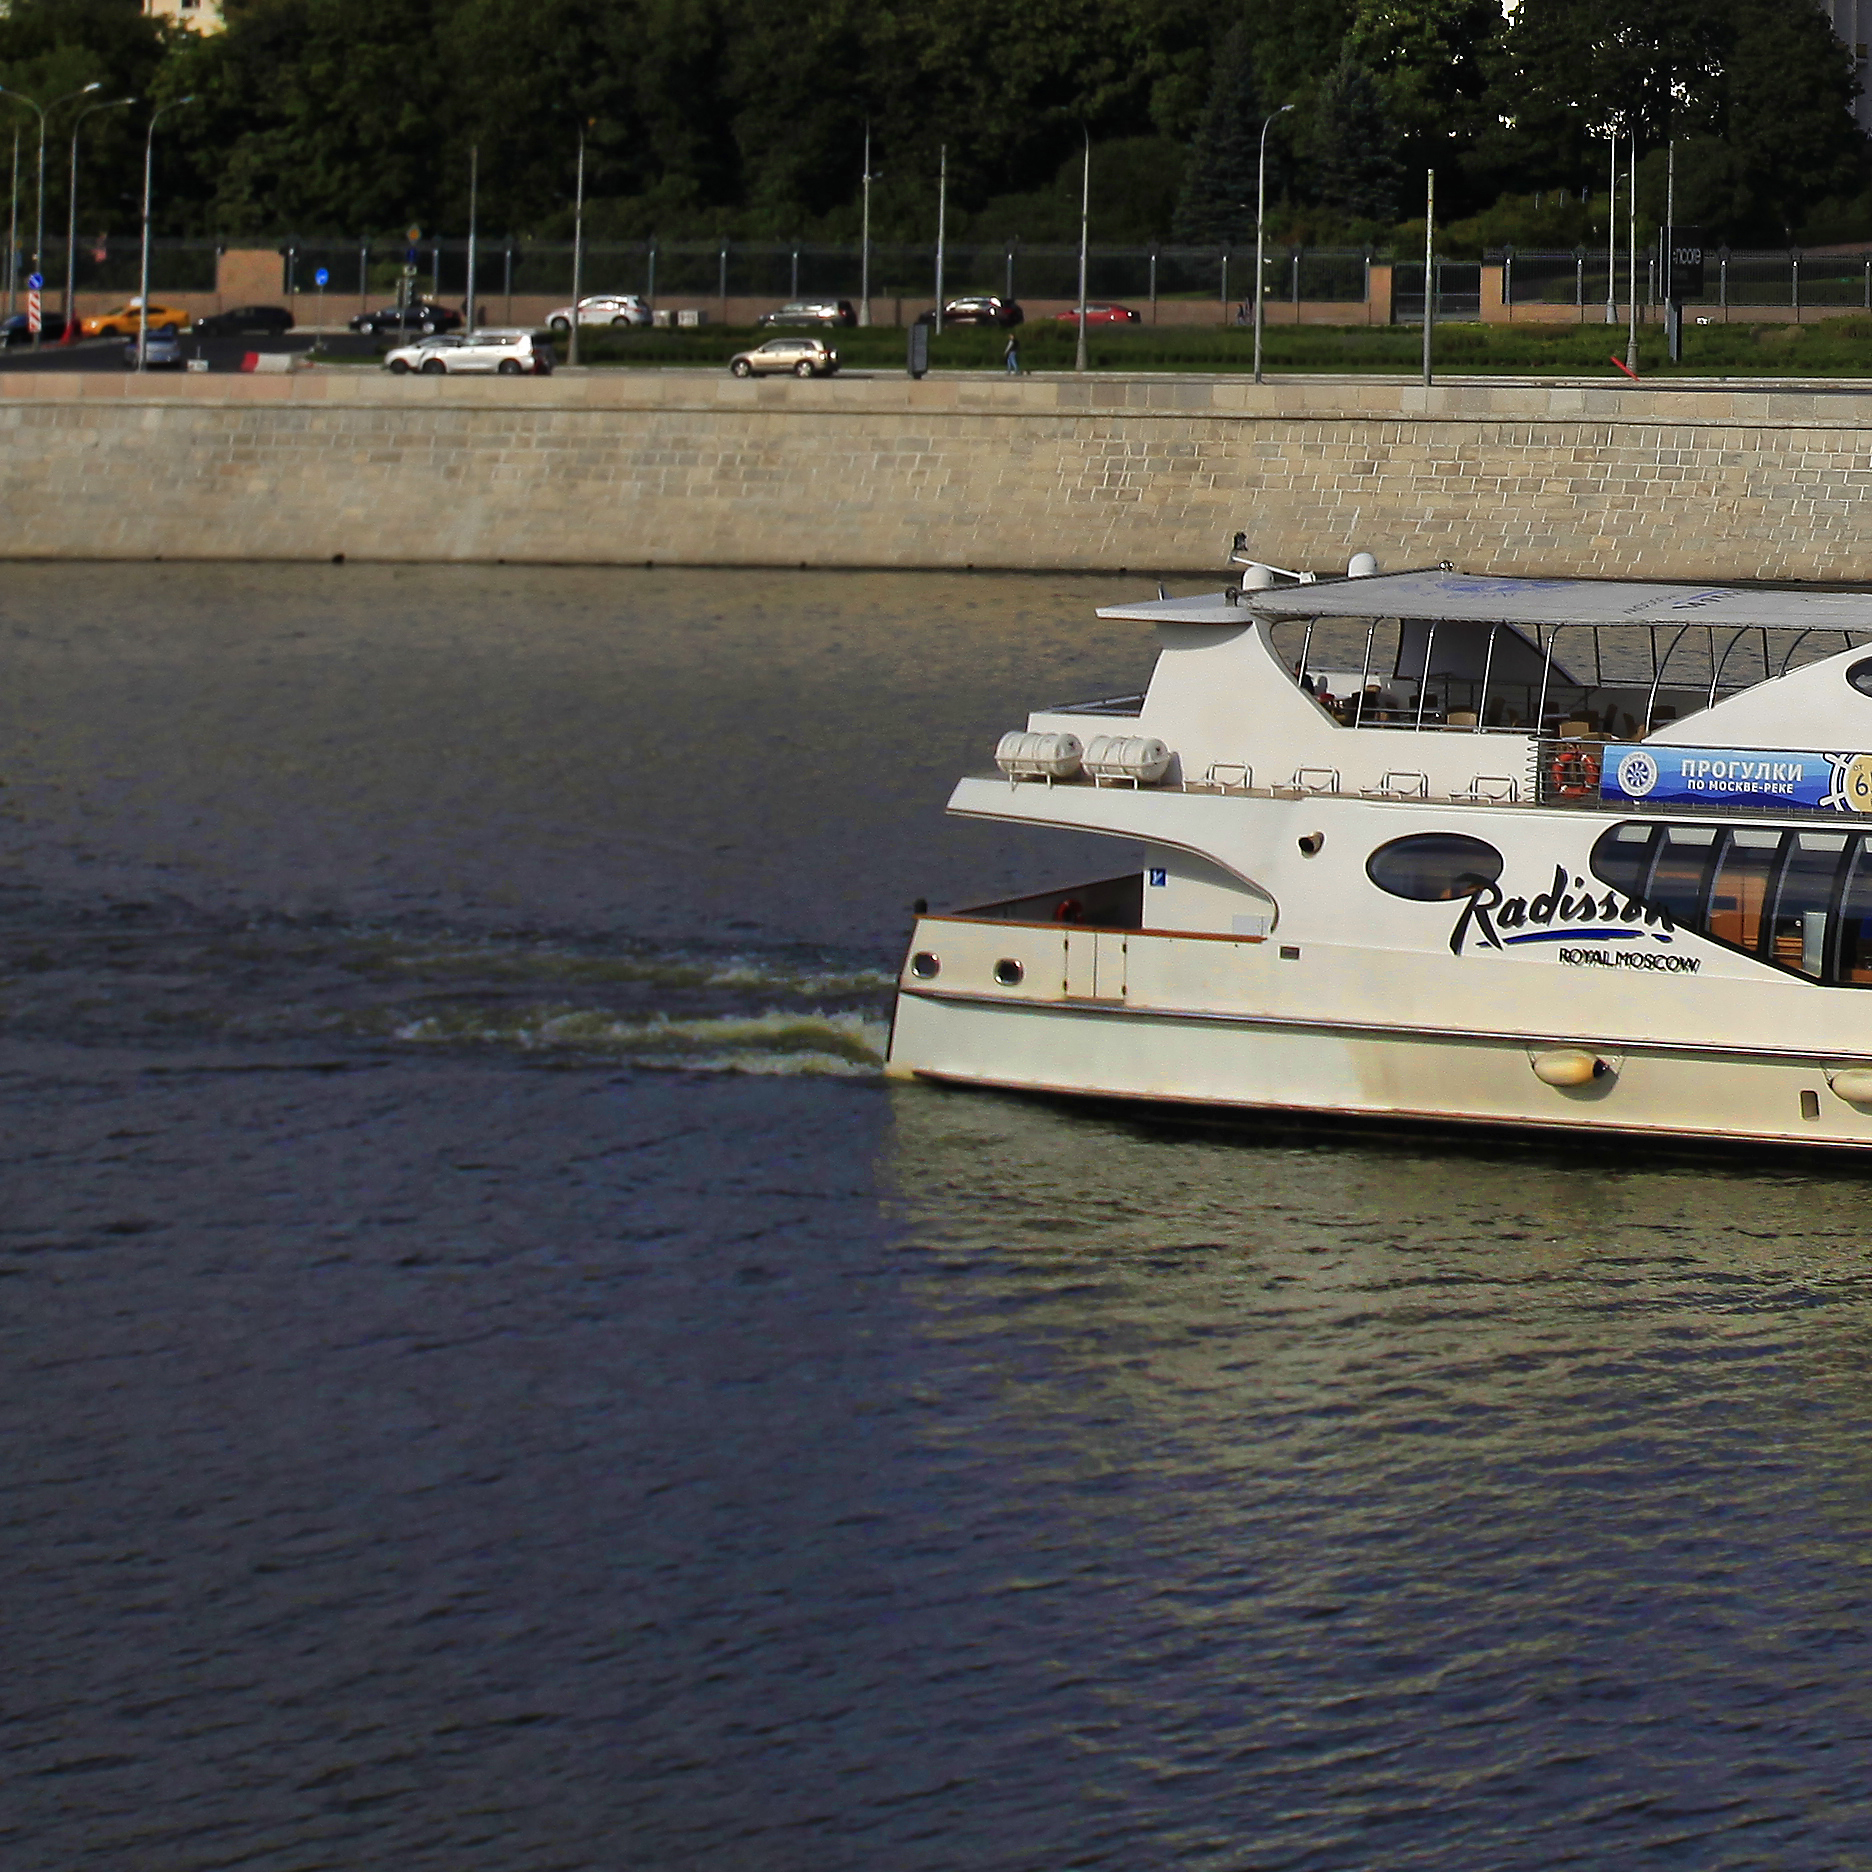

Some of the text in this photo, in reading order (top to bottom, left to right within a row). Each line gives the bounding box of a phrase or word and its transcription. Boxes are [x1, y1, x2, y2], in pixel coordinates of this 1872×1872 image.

[1681, 759, 1803, 782] ПРОГУЛКИ
[1688, 779, 1793, 794] ПО МОСКВЕ-РЕКЕ
[1449, 863, 1676, 956] Radisson
[1559, 947, 1701, 974] ROYAL MOSCOW
